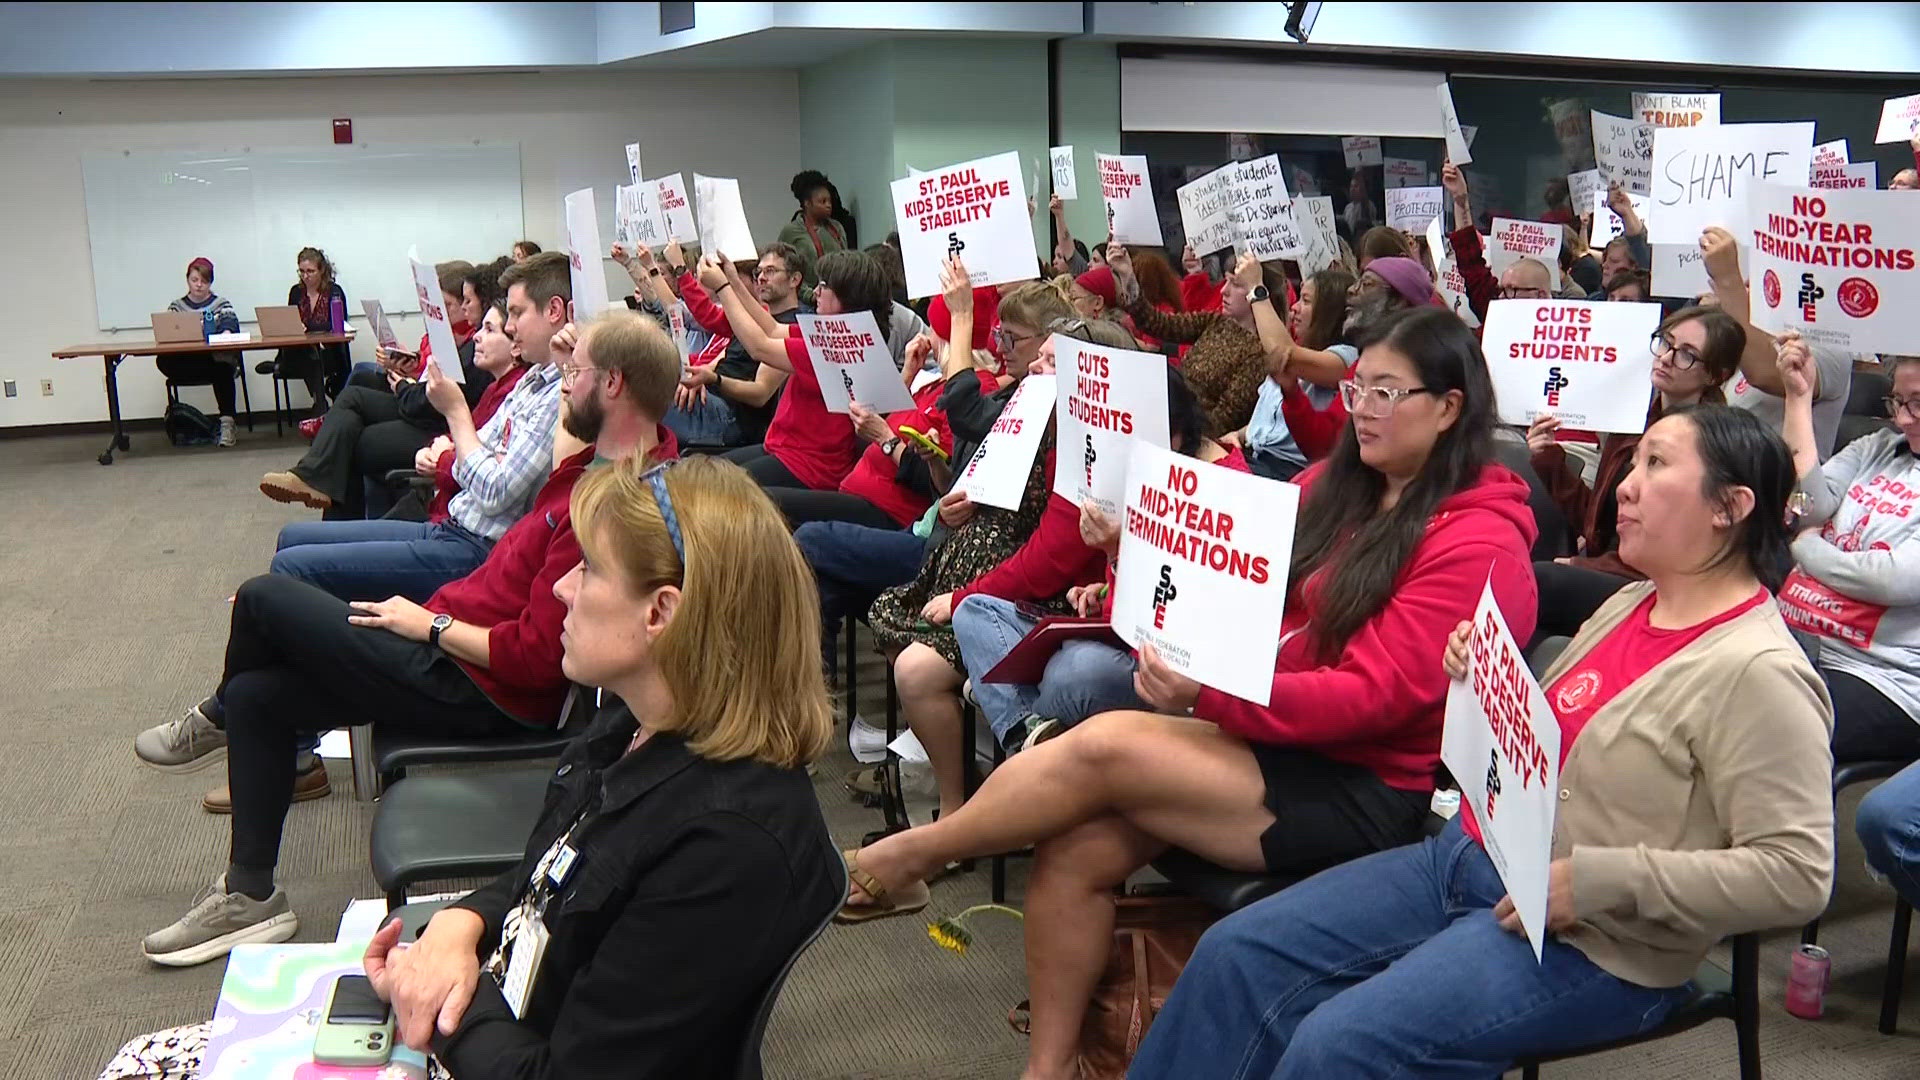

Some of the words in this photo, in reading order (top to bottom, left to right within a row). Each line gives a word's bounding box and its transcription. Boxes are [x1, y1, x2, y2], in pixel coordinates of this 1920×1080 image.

[1672, 96, 1708, 109] BLAME
[1642, 110, 1704, 127] TRUMP
[1104, 160, 1124, 172] PAUL
[1659, 149, 1789, 206] SHAME
[1816, 168, 1846, 180] PAUL
[919, 179, 938, 196] ST.
[940, 168, 981, 191] PAUL
[1811, 178, 1866, 188] DESERVE
[904, 197, 933, 218] KIDS
[936, 180, 1010, 210] DESERVE
[1394, 202, 1444, 217] PROTECTED
[1792, 195, 1826, 218] NO
[920, 202, 993, 232] STABILITY
[1768, 213, 1872, 245] MID-YEAR
[1496, 232, 1514, 242] KIDS
[1516, 234, 1556, 247] DESERVE
[1522, 224, 1544, 236] PAUL
[1504, 242, 1544, 255] STABILITY
[1754, 229, 1916, 270] TERMINATIONS
[828, 320, 852, 334] PAUL
[1536, 306, 1592, 324] CUTS
[808, 334, 828, 348] KIDS
[828, 332, 875, 348] DESERVE
[1533, 325, 1592, 342] HURT
[822, 348, 866, 364] STABILITY
[1077, 350, 1110, 379] CUTS
[1509, 343, 1618, 363] STUDENTS
[1077, 374, 1110, 404] HURT
[990, 418, 1023, 435] ENTS
[1068, 395, 1134, 434] STUDENTS
[1167, 464, 1198, 496] NO
[1140, 484, 1234, 542] MID-YEAR
[1126, 505, 1270, 584] TERMINATIONS
[1787, 582, 1844, 614] STRONG
[1777, 598, 1867, 642] MMUNITIES
[1483, 610, 1499, 658] ST.
[1500, 648, 1532, 720] PAUL
[1472, 665, 1533, 791] STABILITY
[1490, 667, 1548, 790] DESERVE
